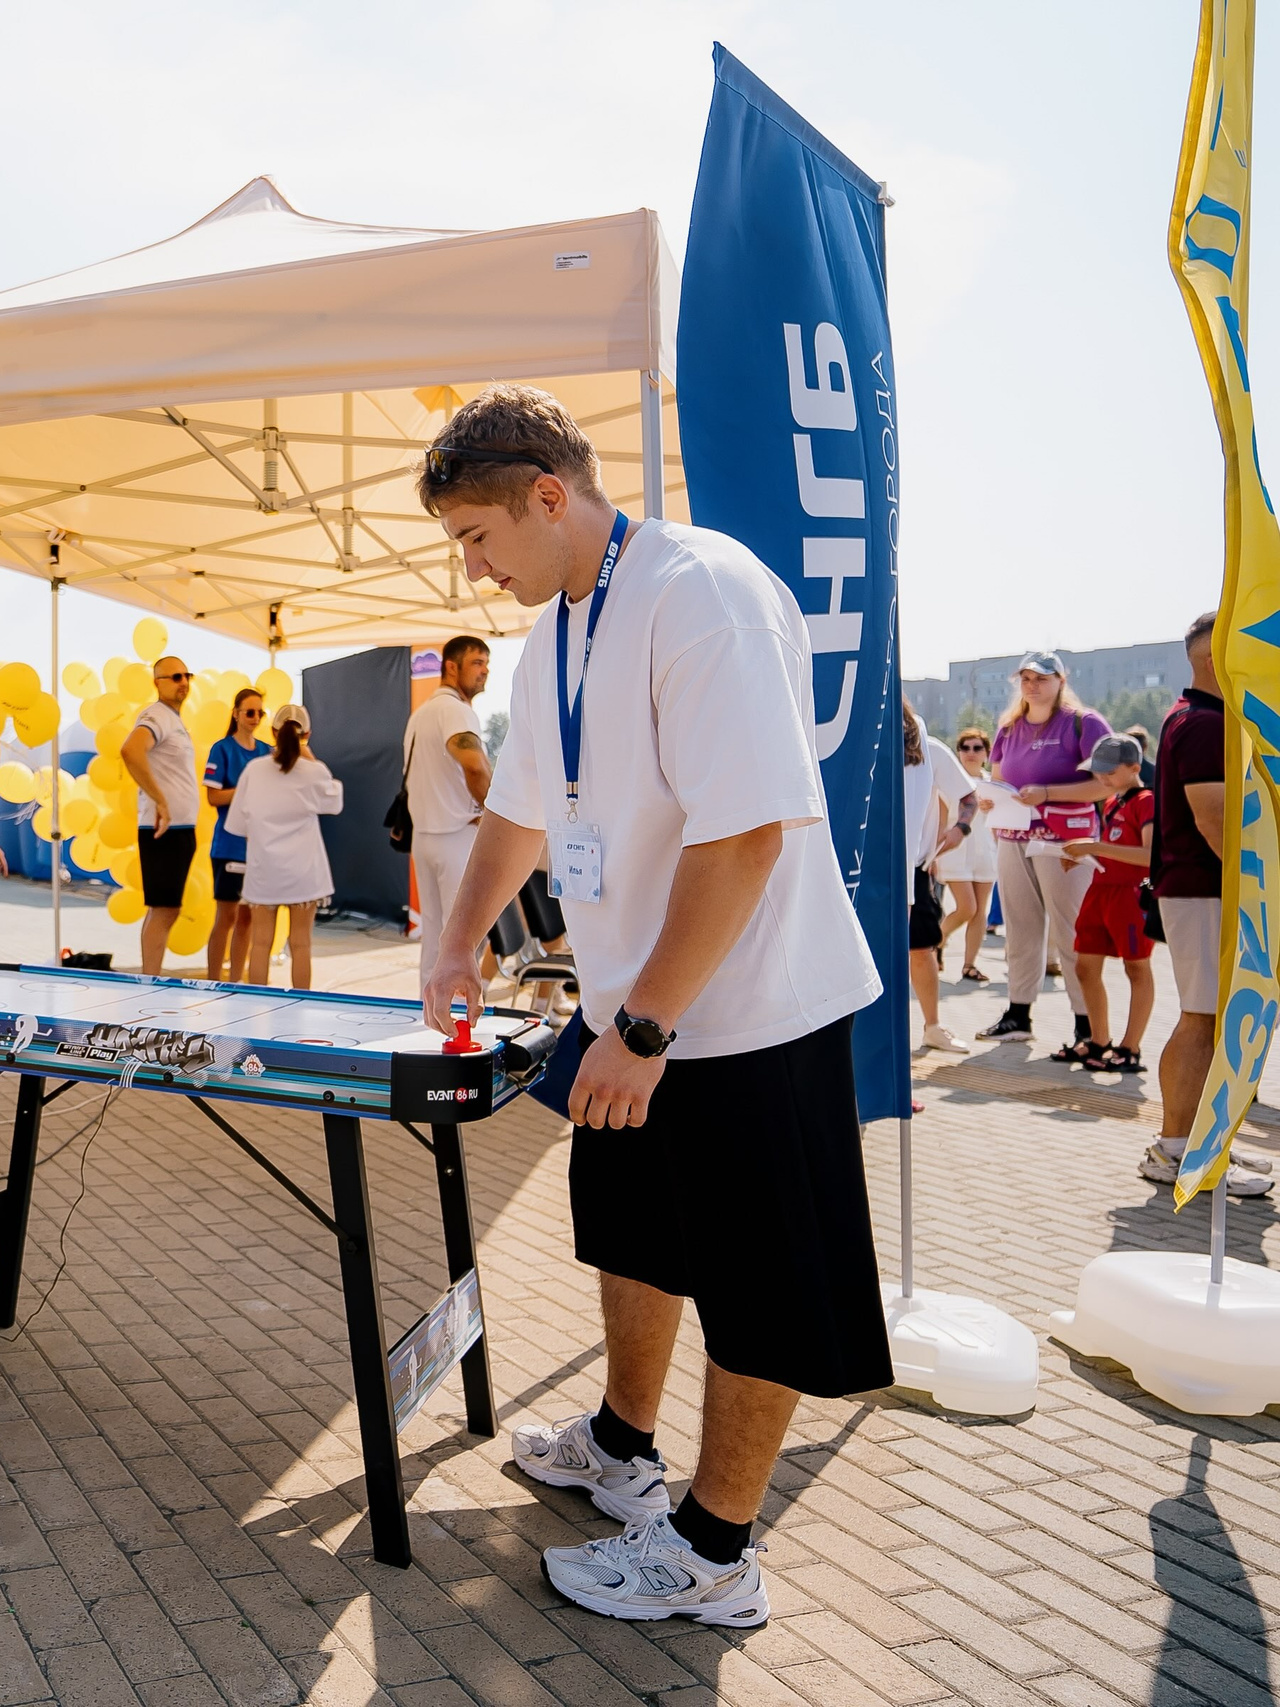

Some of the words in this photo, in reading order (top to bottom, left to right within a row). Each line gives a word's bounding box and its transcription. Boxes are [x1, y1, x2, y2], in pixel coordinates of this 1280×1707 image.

[598, 557, 614, 588] СНГБ
[89, 1049, 114, 1061] Play
[456, 1090, 467, 1100] 86
[468, 1088, 478, 1099] RU
[640, 1565, 679, 1591] N
